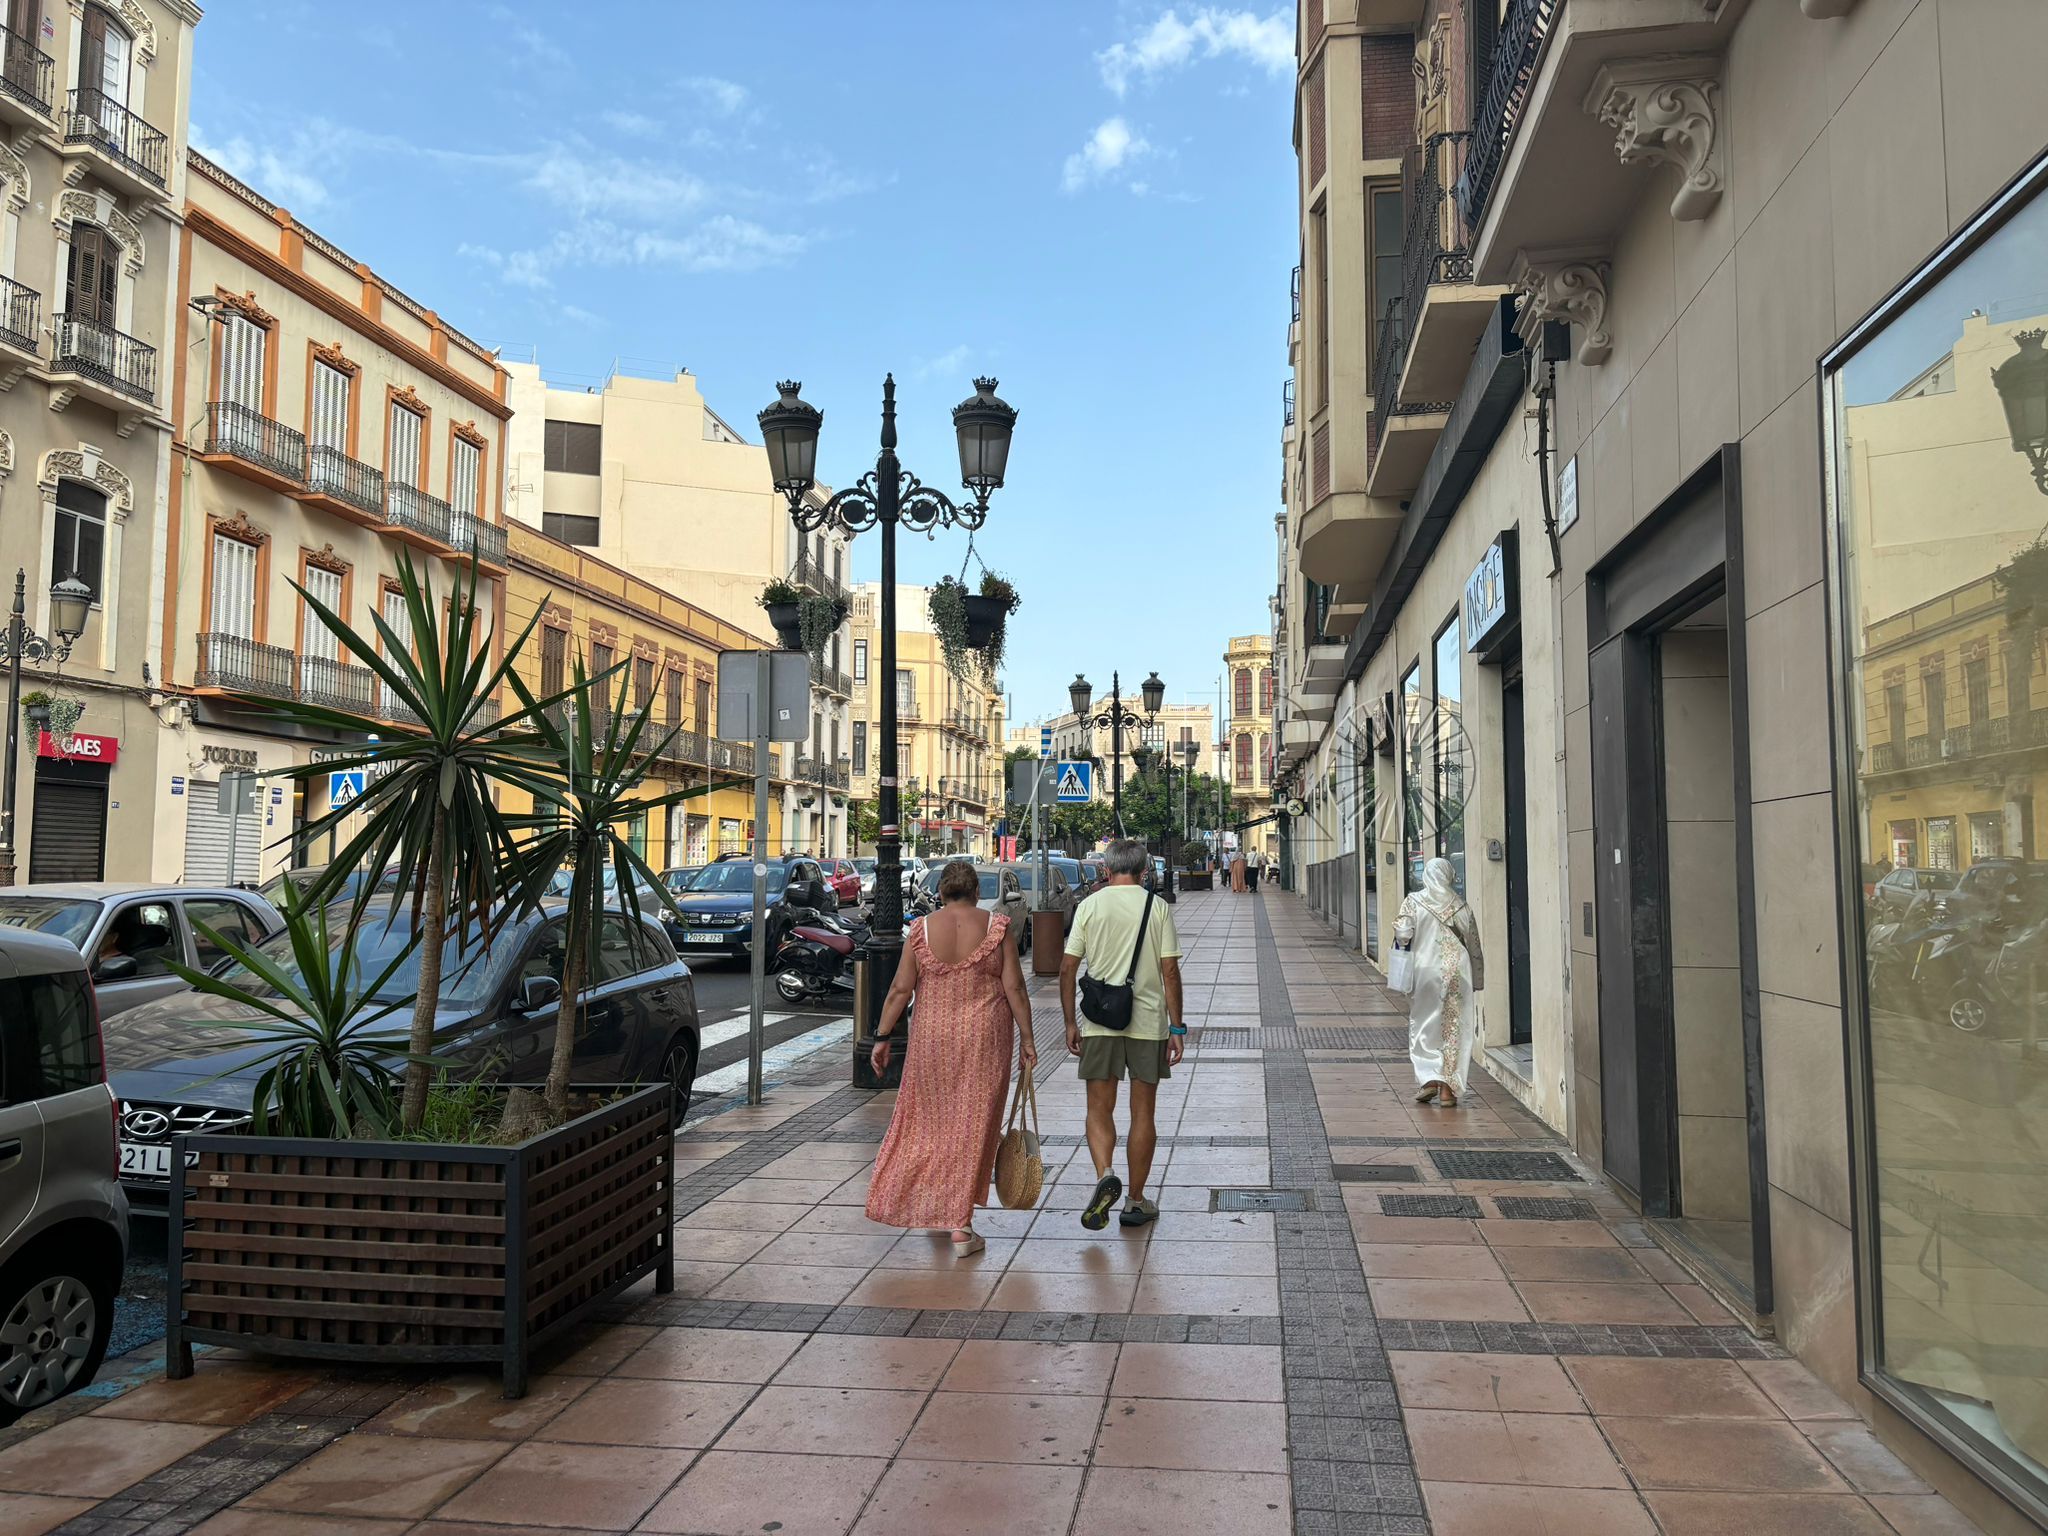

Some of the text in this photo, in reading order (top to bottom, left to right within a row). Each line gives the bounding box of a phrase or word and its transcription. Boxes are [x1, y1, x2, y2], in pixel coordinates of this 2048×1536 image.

[1466, 546, 1502, 640] INSIDE
[61, 736, 102, 757] GAES
[201, 744, 258, 766] TORRES
[688, 933, 722, 942] 2022 JZS
[120, 1147, 147, 1170] 21
